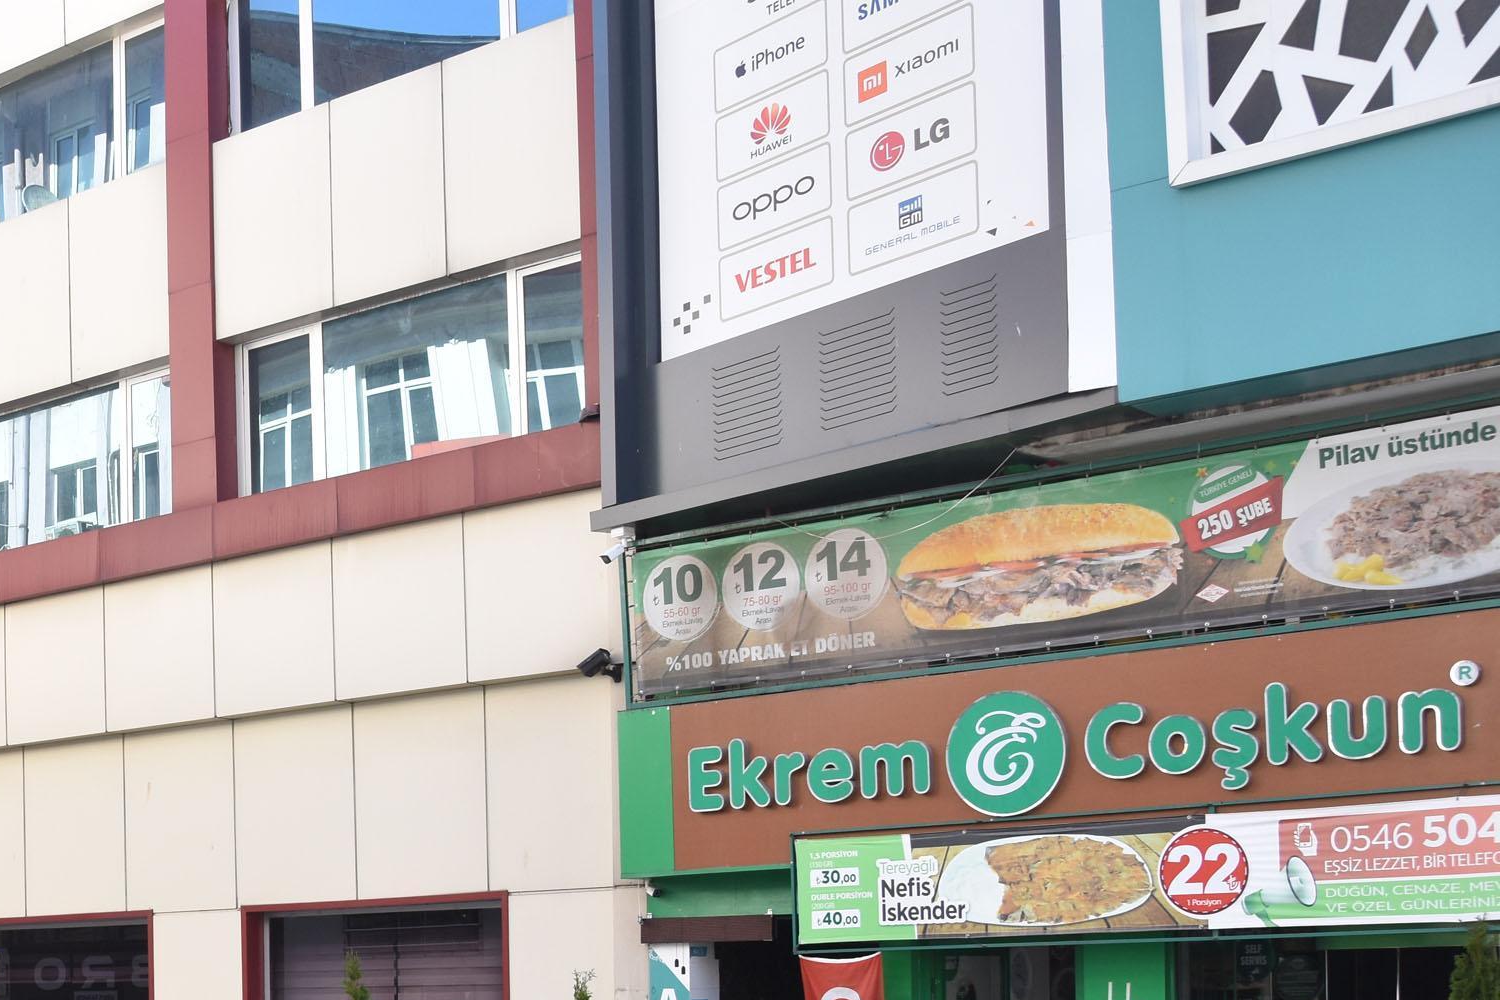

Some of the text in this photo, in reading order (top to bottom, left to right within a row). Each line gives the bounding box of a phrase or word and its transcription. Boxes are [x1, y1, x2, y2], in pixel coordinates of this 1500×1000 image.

[751, 36, 805, 72] iPhone
[750, 135, 792, 159] HUAWEI
[914, 117, 949, 151] LG
[864, 215, 961, 256] GENERAL MOBILE
[734, 247, 817, 293] VESTEL
[1319, 421, 1498, 469] Pilav üstünde
[1197, 497, 1273, 541] 250 ŞUBE
[666, 653, 712, 672] %100
[718, 643, 785, 665] YAPRAK
[815, 631, 876, 654] DÖNER
[687, 737, 932, 813] Ekrem
[1085, 681, 1462, 790] Coşkun
[1330, 822, 1413, 852] 0546
[821, 850, 858, 860] PORSİYON
[880, 859, 936, 875] Tereyağlı
[1325, 857, 1363, 876] EŞSİZ
[1365, 855, 1421, 871] LEZZET,
[1424, 851, 1446, 868] BİR
[811, 891, 873, 901] DUBLE PORSİYON
[881, 877, 931, 898] Nefis
[882, 899, 966, 922] İskender
[1192, 898, 1222, 906] Porsiyon
[1326, 902, 1348, 913] VE
[1352, 899, 1396, 912] ÖZEL
